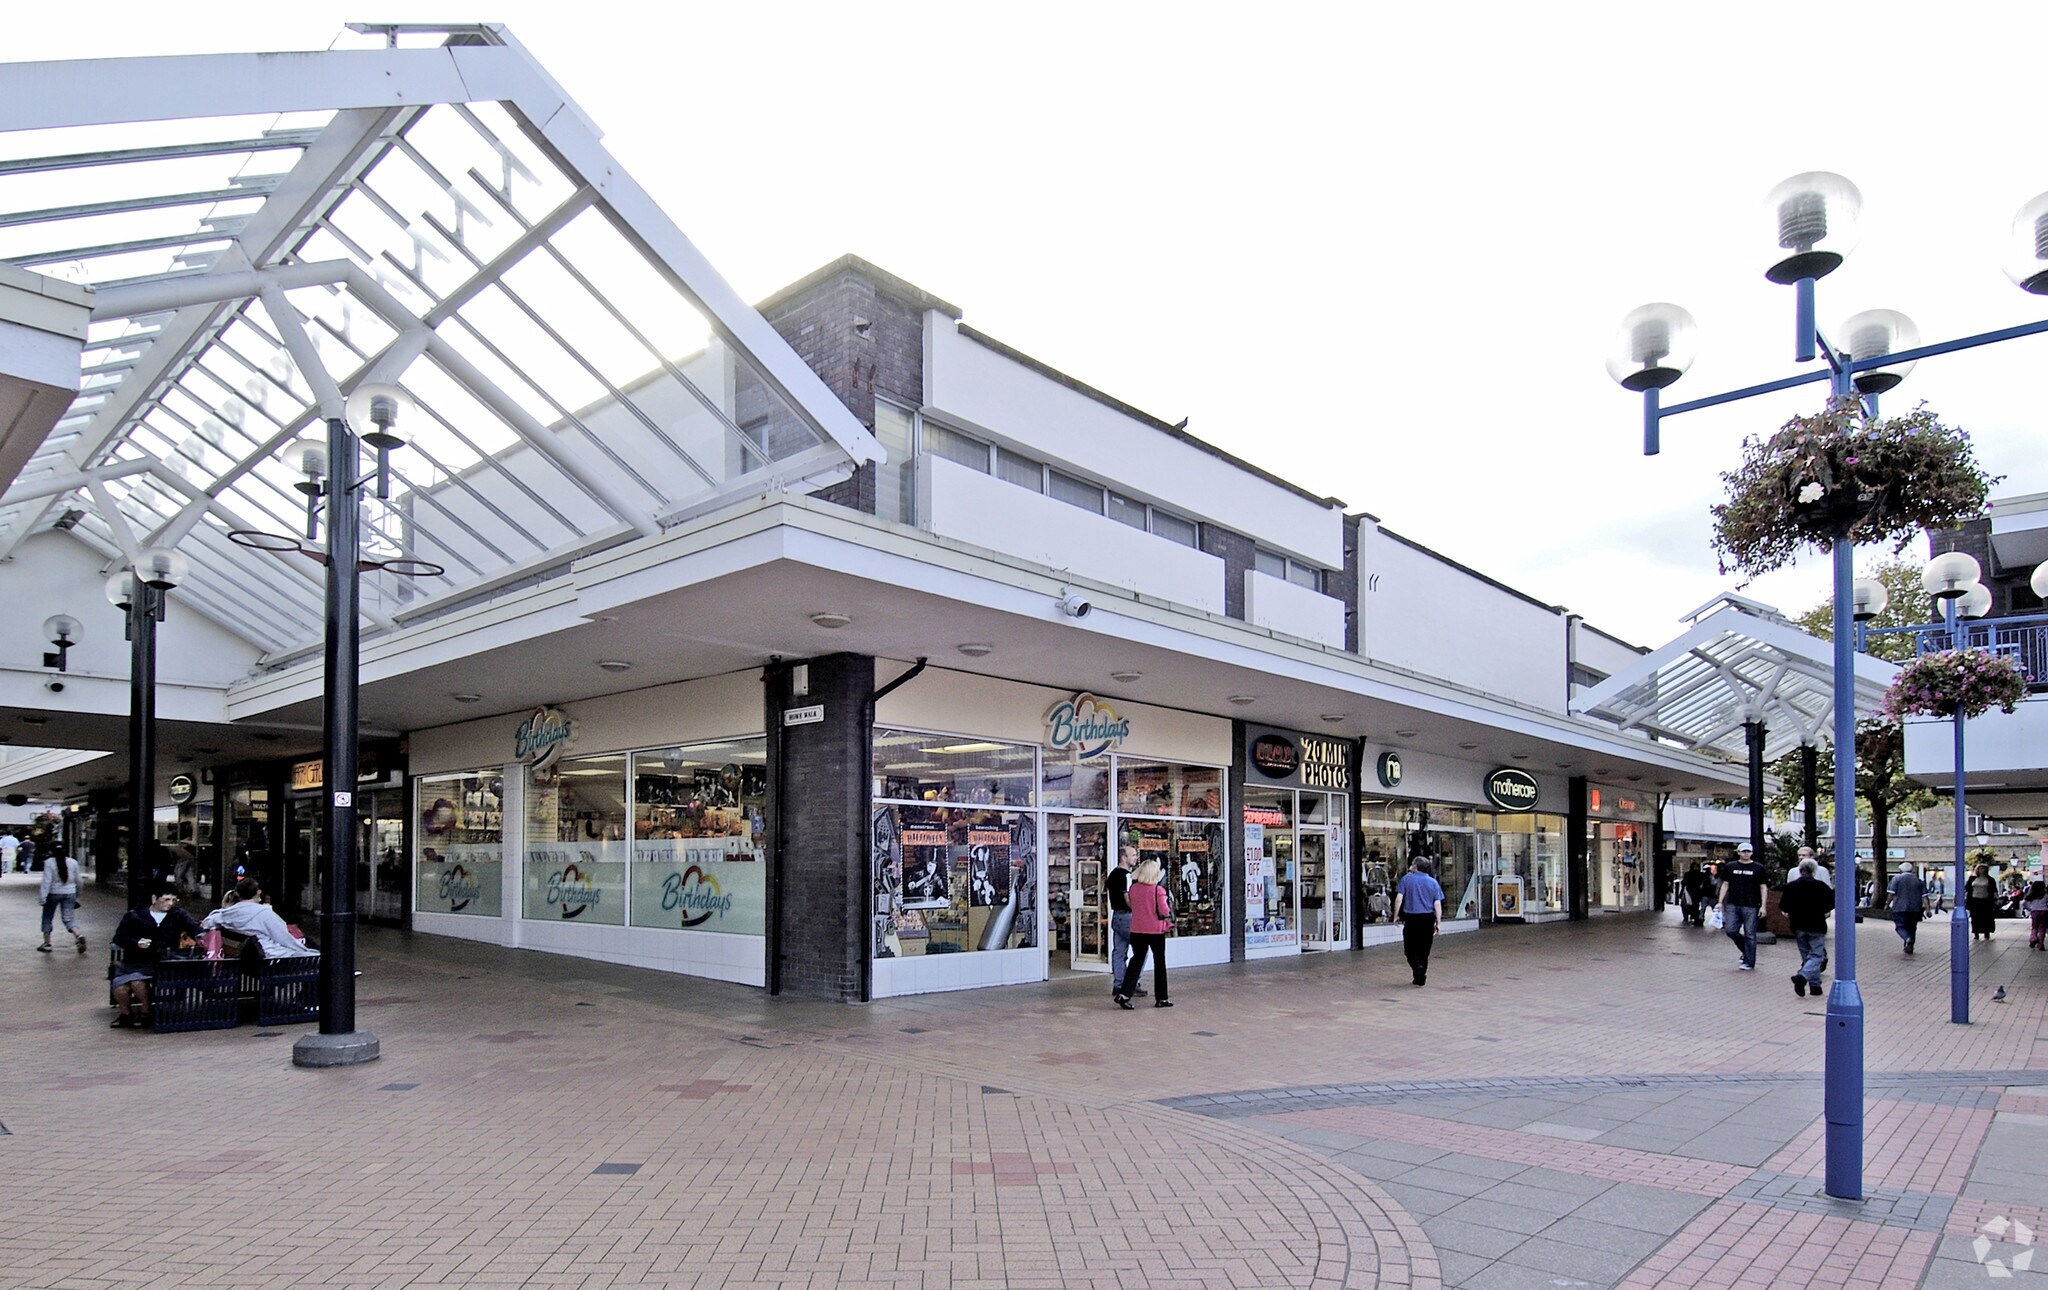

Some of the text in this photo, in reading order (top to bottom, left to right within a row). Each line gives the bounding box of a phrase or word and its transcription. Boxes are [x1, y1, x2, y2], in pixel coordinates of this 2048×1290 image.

[514, 720, 571, 758] Birthdays
[1050, 703, 1129, 746] Birthdays
[1301, 762, 1350, 788] PHOTOS
[1493, 778, 1535, 799] mothercare
[1248, 863, 1260, 877] OFF
[439, 871, 481, 904] Birthdays
[546, 872, 601, 912] Birthdays
[661, 872, 732, 917] Birthdays
[1246, 883, 1263, 898] FILM
